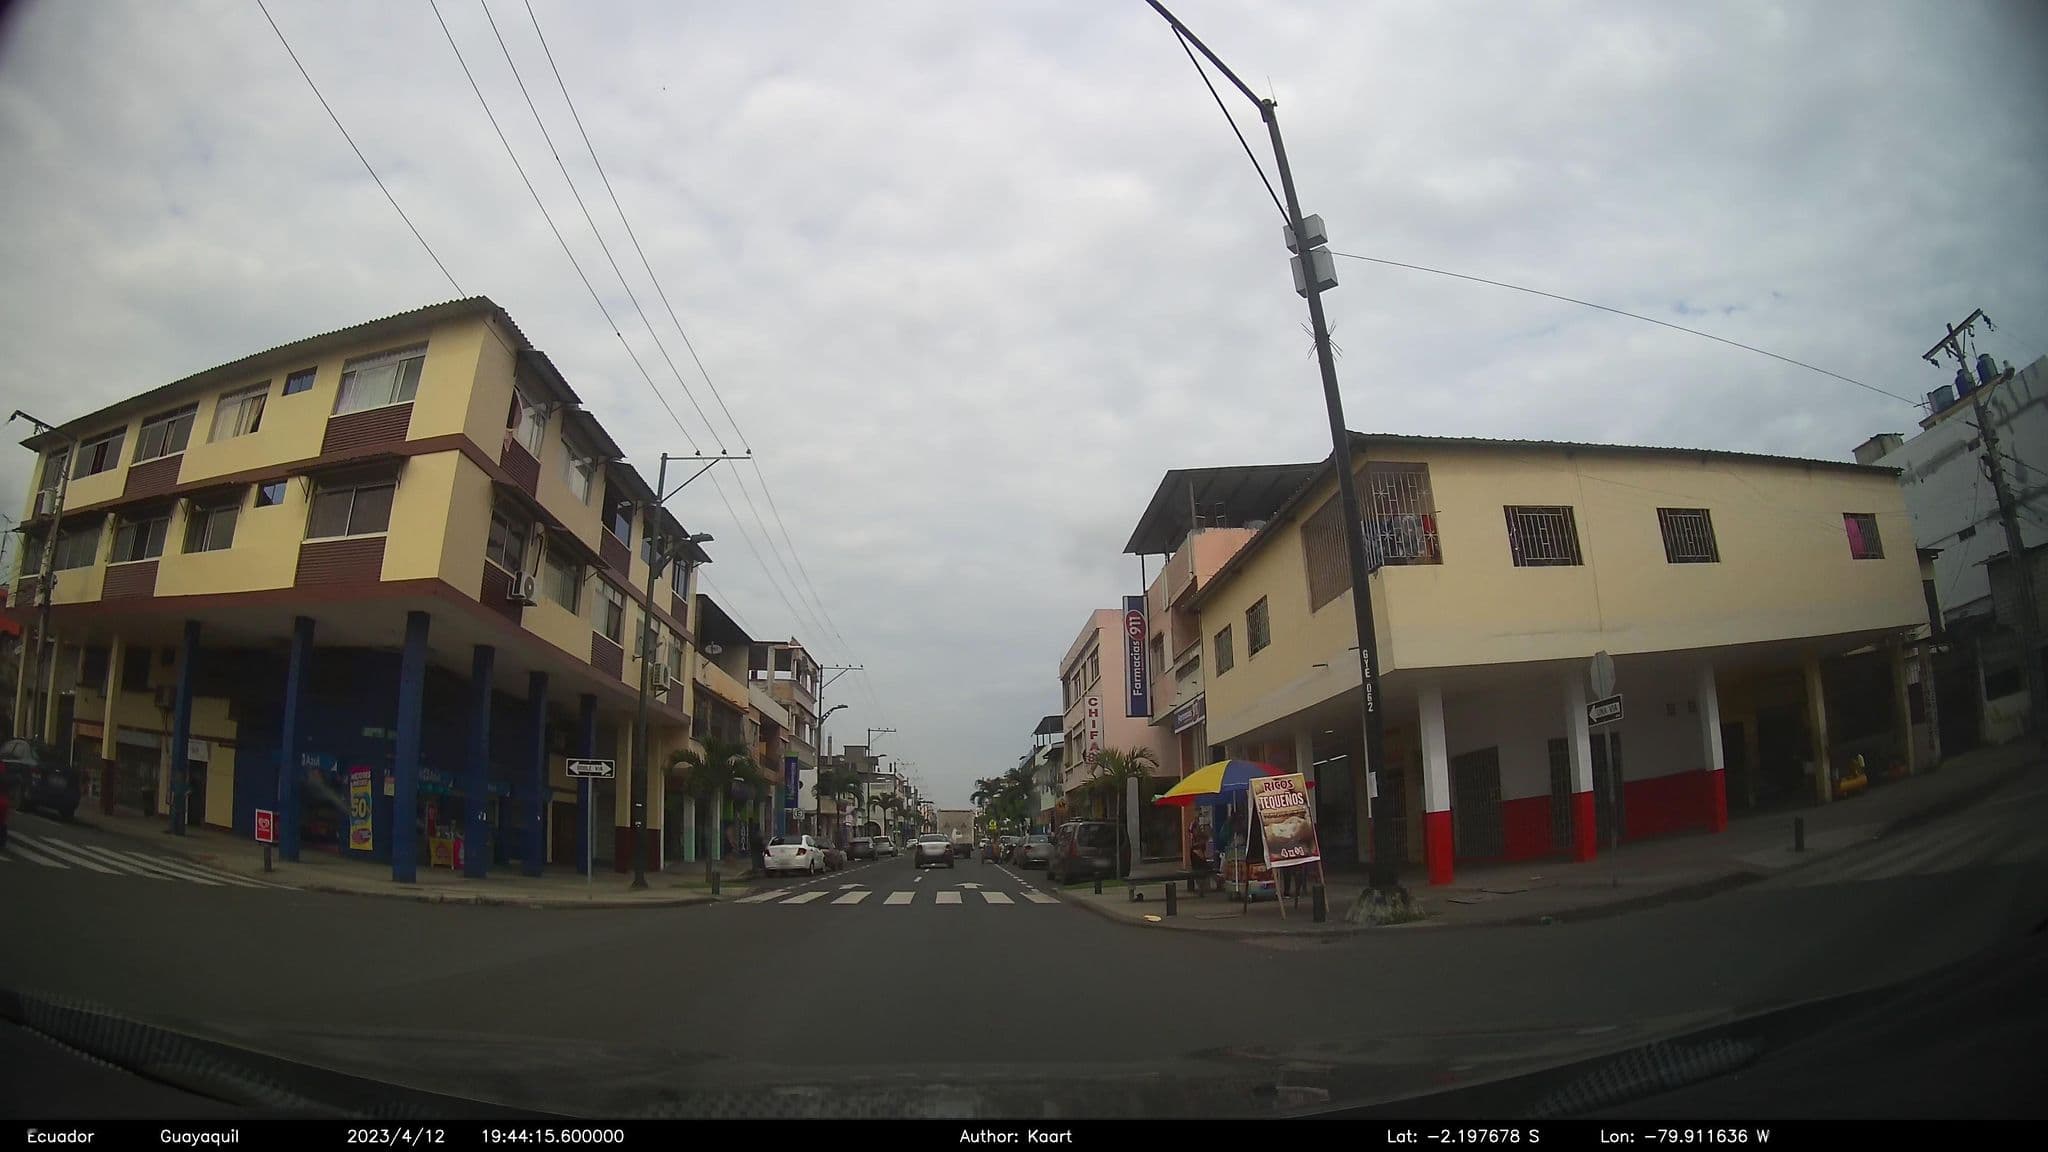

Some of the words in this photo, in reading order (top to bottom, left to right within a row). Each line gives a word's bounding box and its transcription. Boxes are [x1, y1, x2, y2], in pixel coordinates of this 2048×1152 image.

[1129, 616, 1141, 636] 911
[1131, 640, 1143, 697] Farmacias
[1366, 683, 1374, 712] 062
[1259, 791, 1304, 809] TEQUEÑOS
